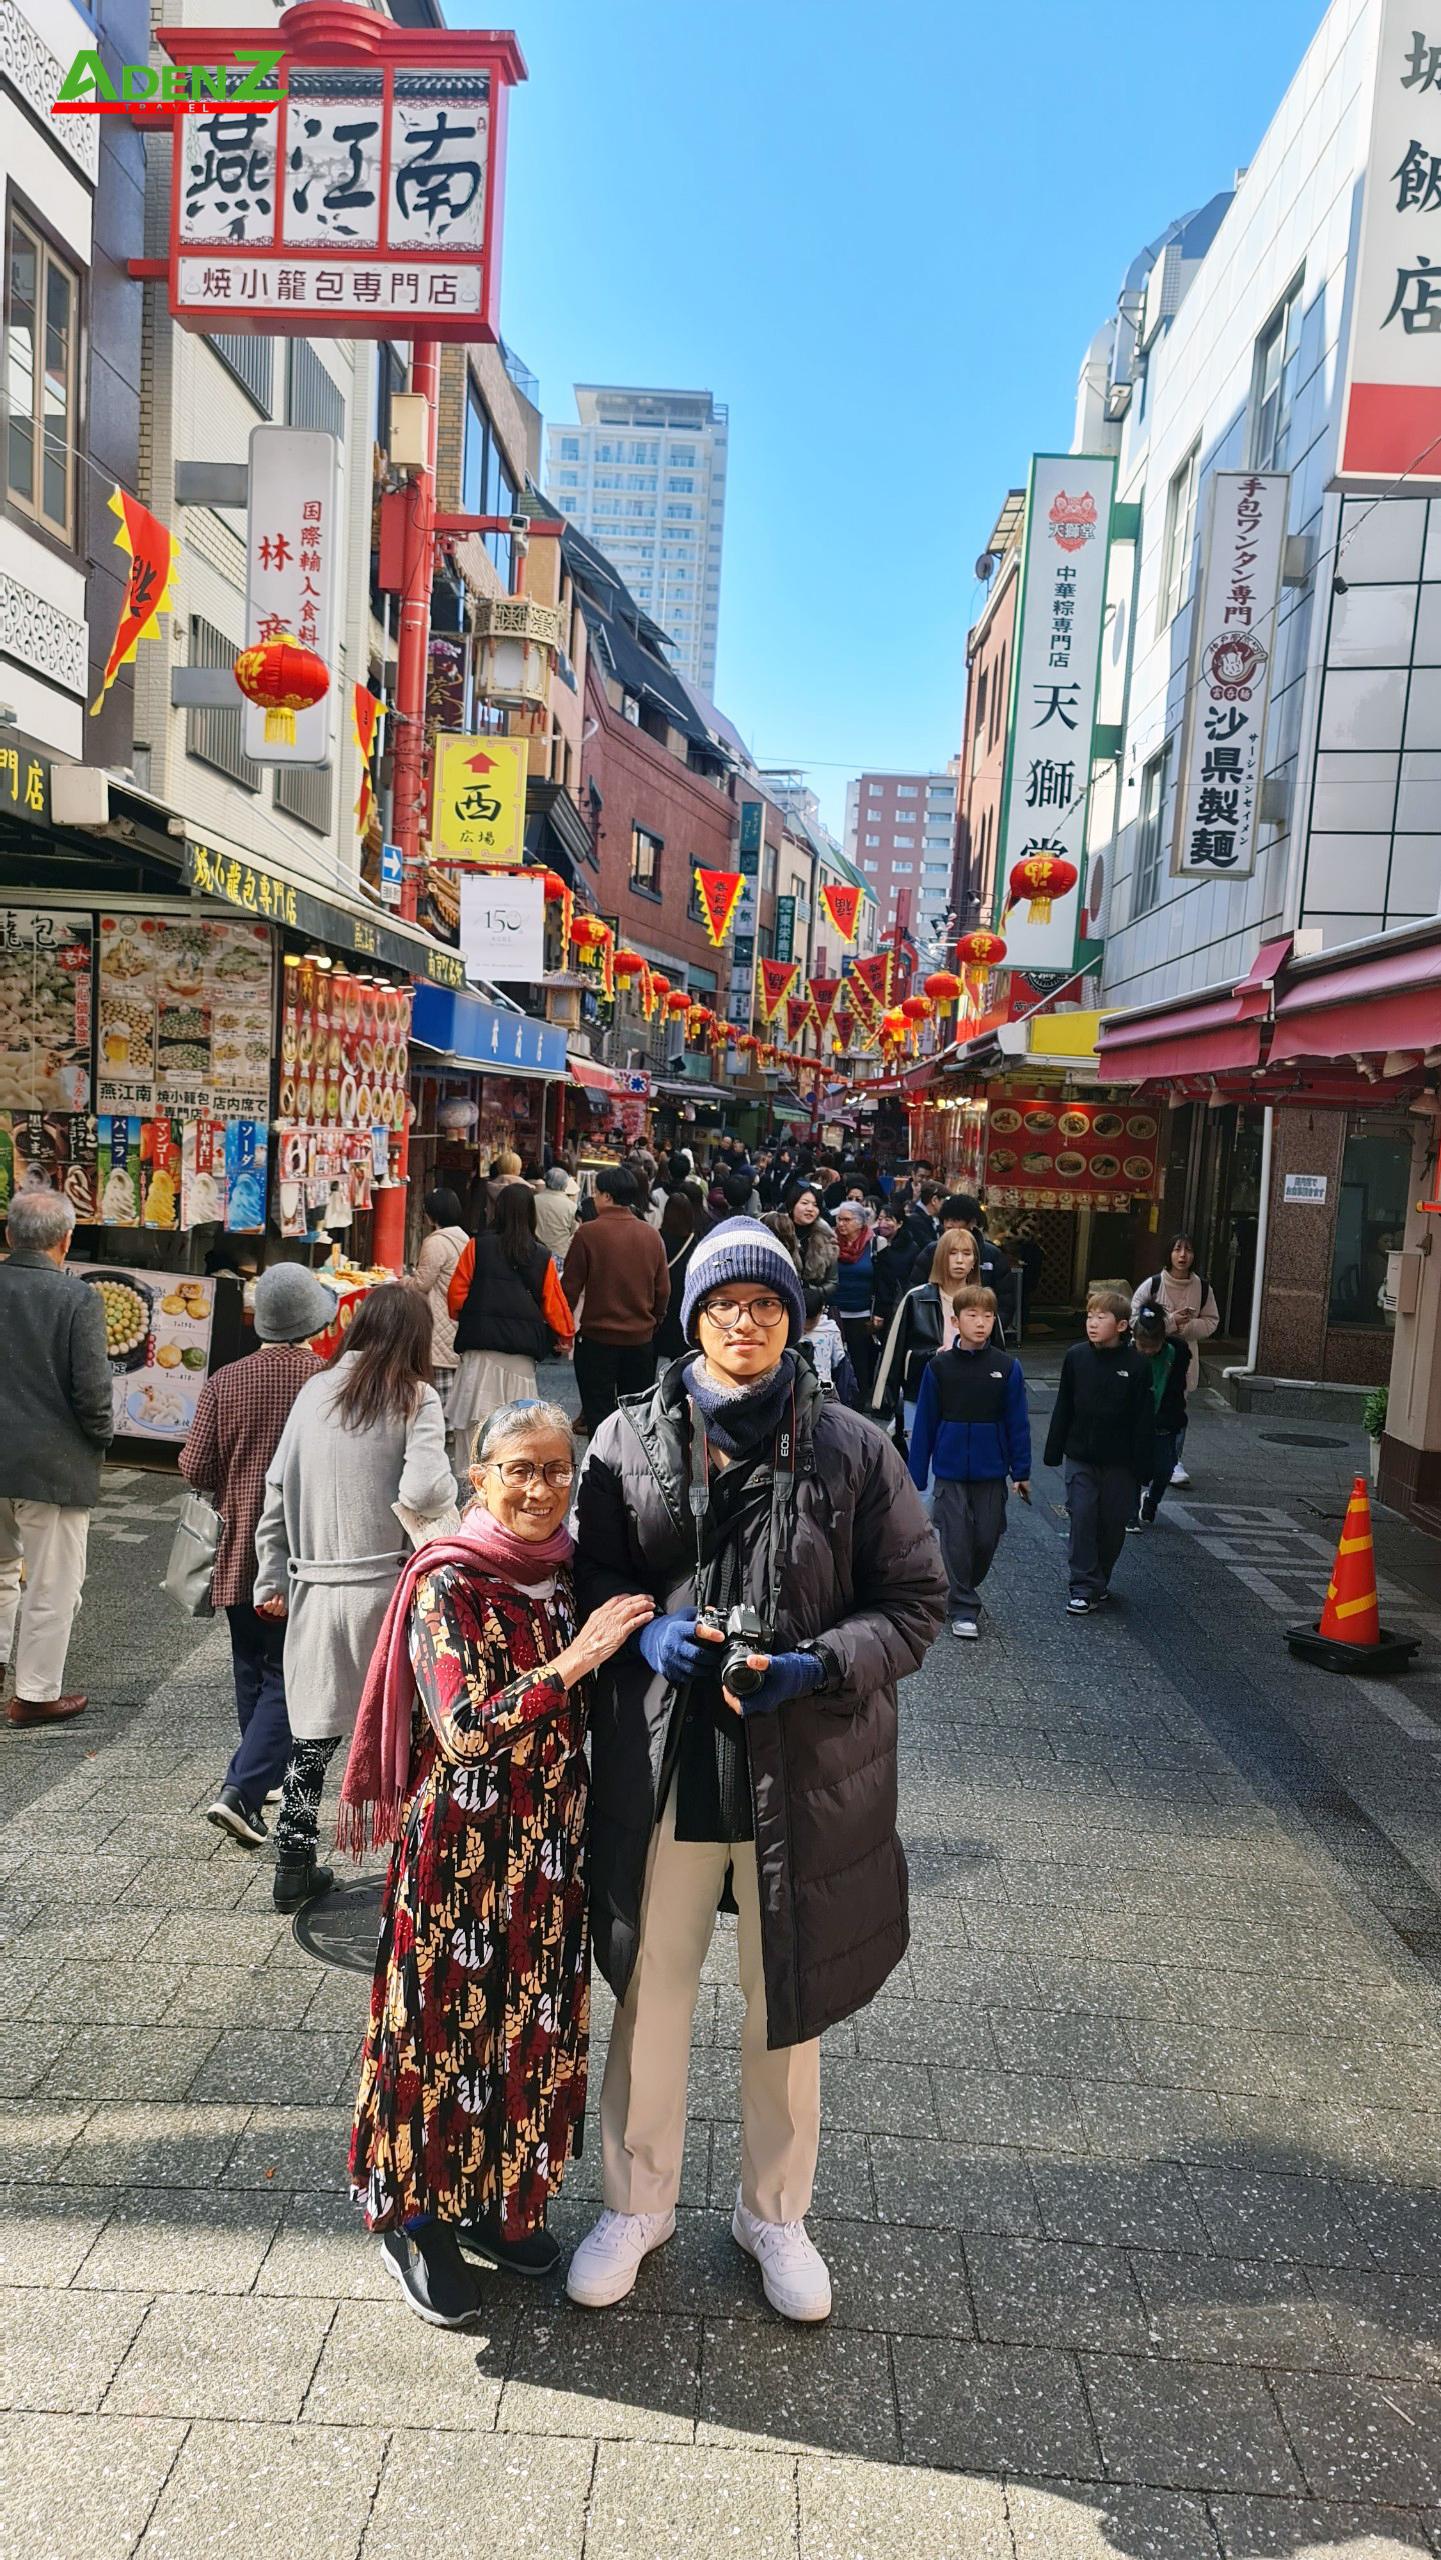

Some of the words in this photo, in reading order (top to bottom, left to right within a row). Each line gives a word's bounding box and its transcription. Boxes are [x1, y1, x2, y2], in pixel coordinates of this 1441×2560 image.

[186, 112, 482, 220] 燕江南
[202, 267, 458, 305] 焼小籠包専門店
[1049, 522, 1096, 539] 天獅堂
[1224, 477, 1267, 626] 手包ワンタン専門
[1049, 566, 1077, 668] 中華粽専門店
[455, 784, 501, 822] 西
[1239, 733, 1258, 846] サーシェンセイメン
[460, 830, 495, 846] 広場
[484, 909, 522, 934] 150
[100, 1083, 152, 1102] 燕江南
[213, 1096, 268, 1112] 店内席で
[113, 1120, 127, 1157] バニラ
[156, 1123, 168, 1164] マンゴー
[242, 1126, 253, 1166] ソーダ
[781, 1433, 790, 1457] EOS
